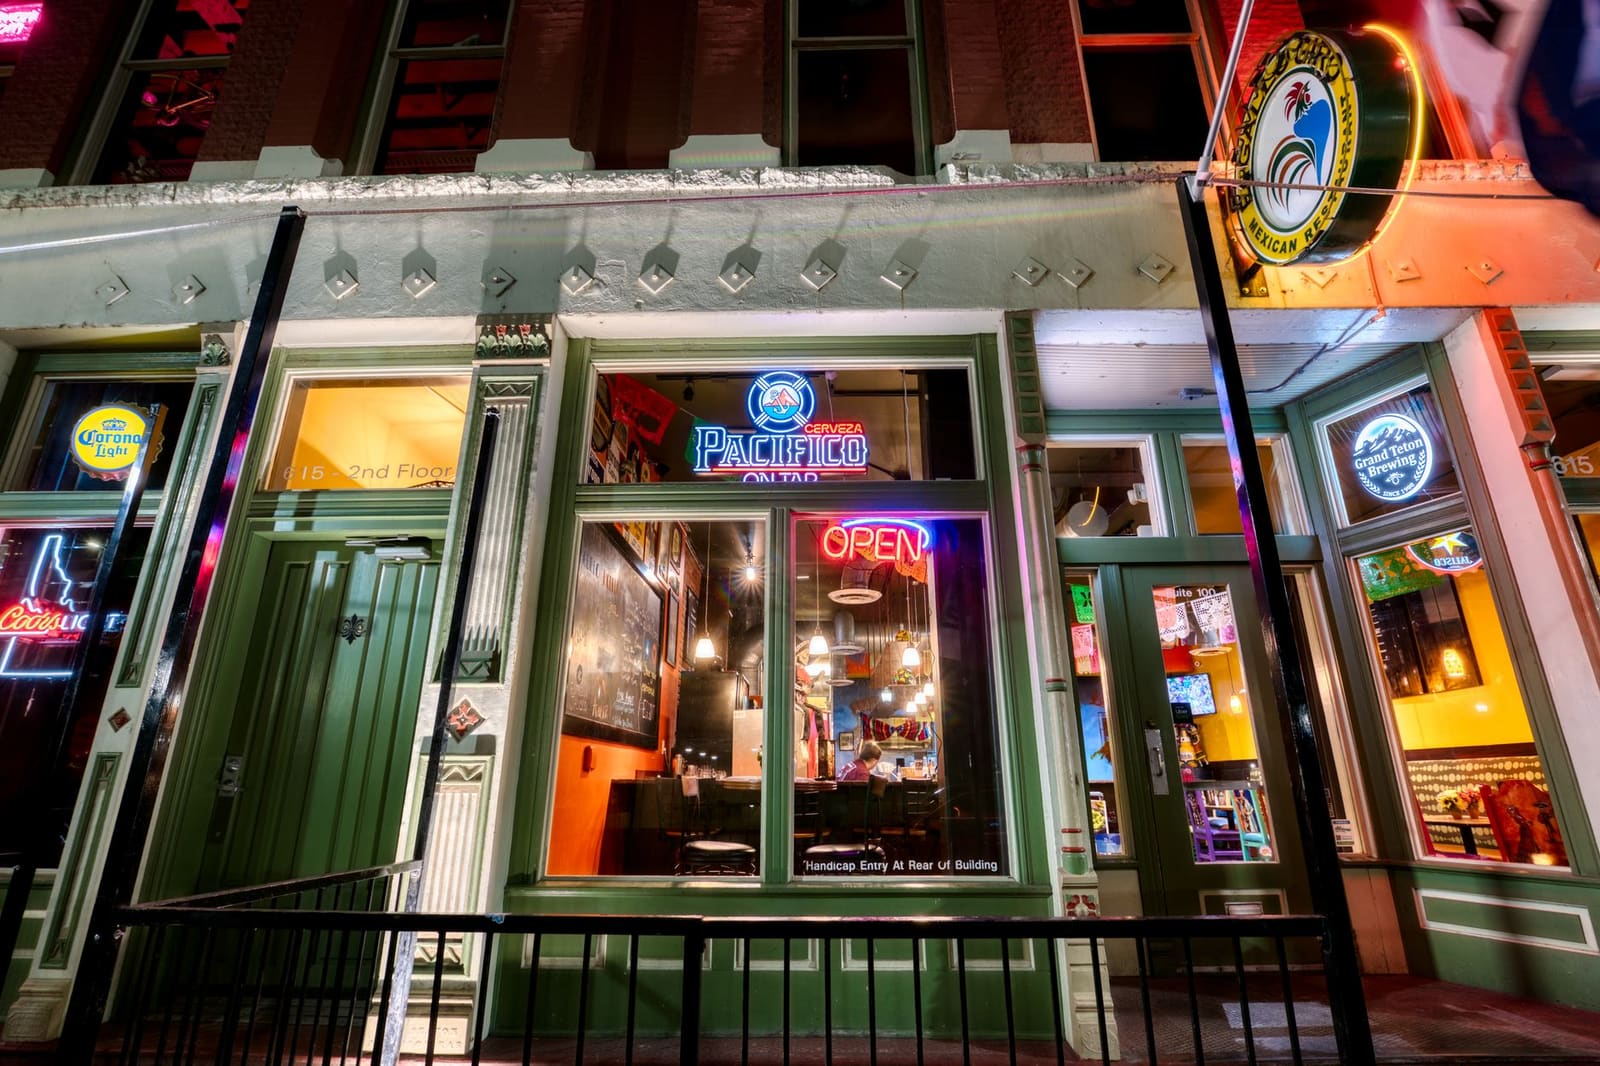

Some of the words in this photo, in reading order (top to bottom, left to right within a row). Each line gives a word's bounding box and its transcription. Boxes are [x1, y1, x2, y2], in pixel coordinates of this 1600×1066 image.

[1248, 216, 1298, 254] MEXICAN
[78, 429, 143, 447] Corona
[804, 423, 863, 434] CERVEZA
[95, 444, 128, 457] Light
[693, 426, 868, 472] PACIFICO
[1354, 448, 1389, 470] Grand
[1389, 438, 1424, 457] Teton
[283, 465, 325, 480] 615
[349, 464, 390, 479] 2nd
[397, 463, 453, 479] Floor
[1367, 453, 1418, 478] Brewing
[1551, 455, 1594, 474] 615
[823, 526, 922, 561] OPEN
[1196, 587, 1216, 597] 100
[0, 606, 62, 631] Coors
[805, 860, 856, 873] Handicap
[860, 860, 888, 872] Entry
[893, 860, 904, 871] At
[908, 859, 933, 870] Rear
[955, 859, 998, 873] Building
